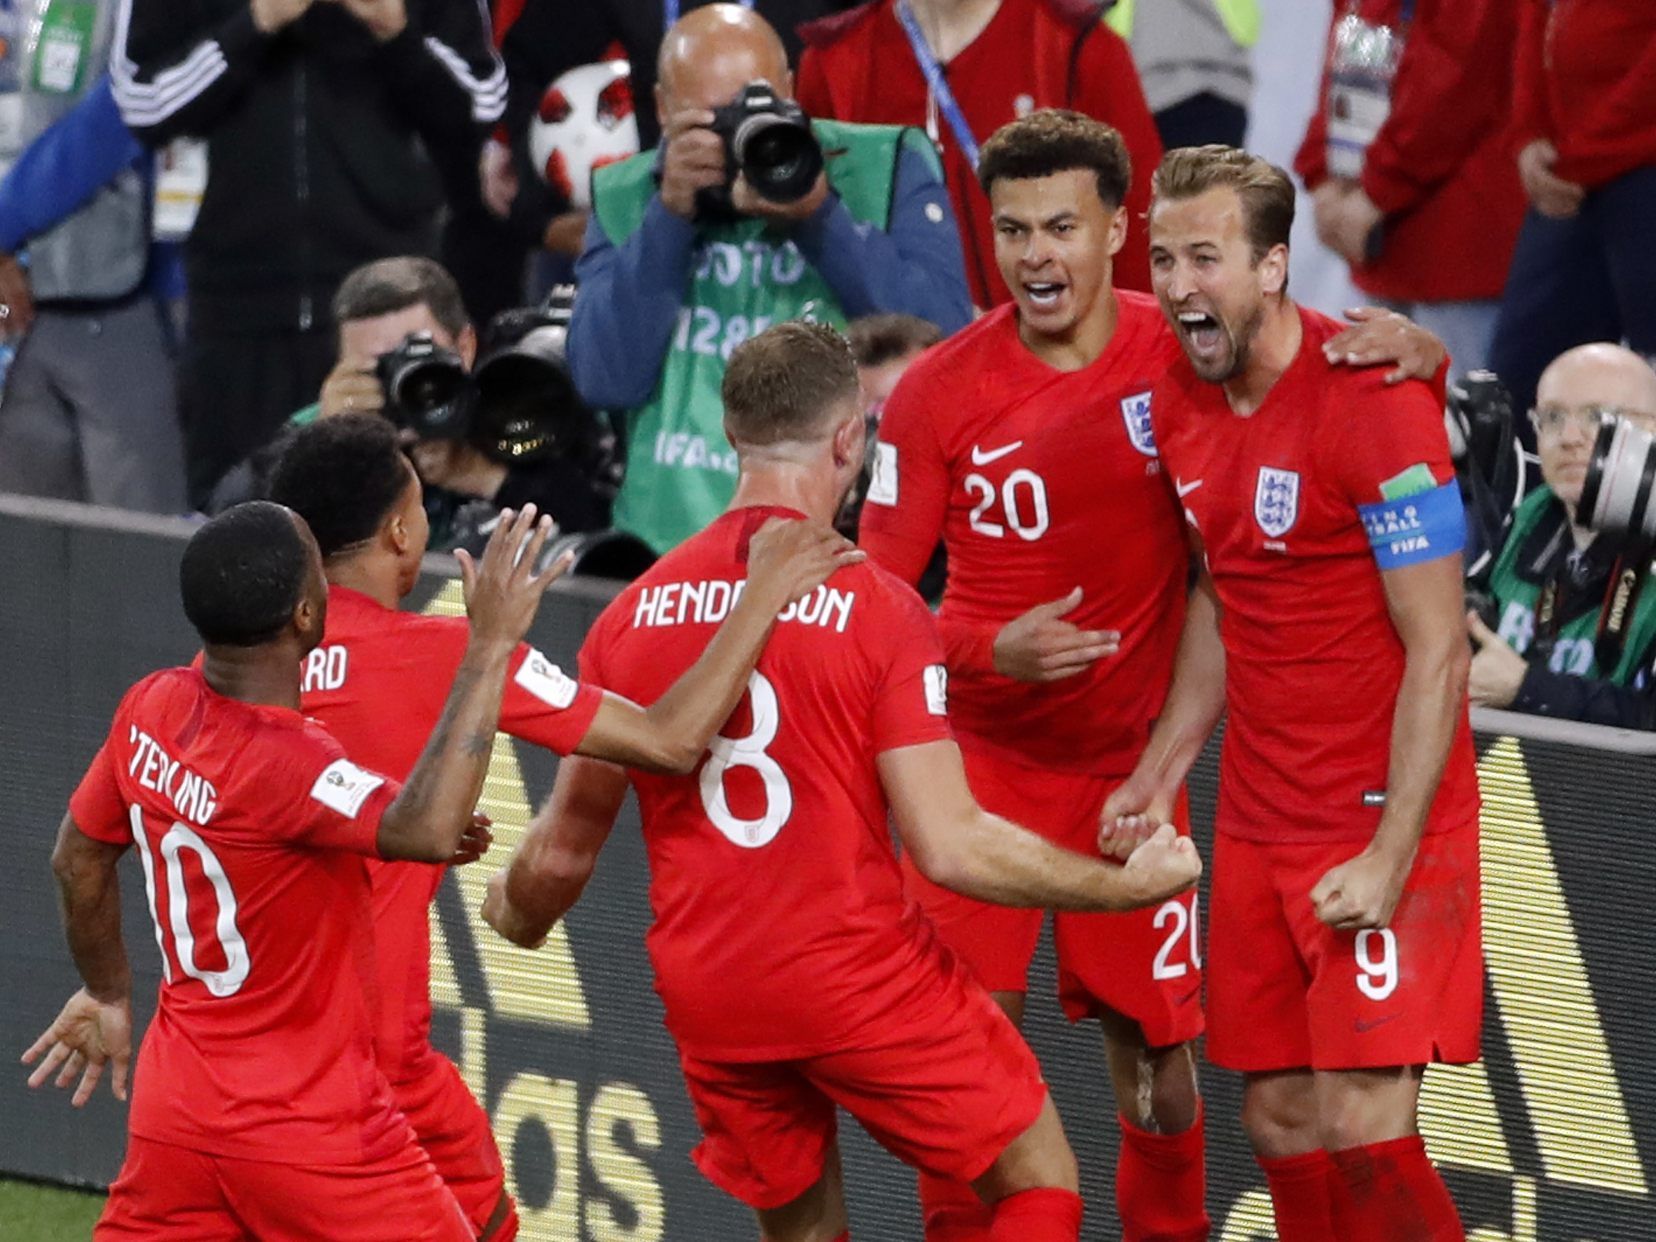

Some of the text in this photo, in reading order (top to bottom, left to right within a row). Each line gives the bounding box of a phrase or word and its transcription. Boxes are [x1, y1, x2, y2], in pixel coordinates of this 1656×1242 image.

[695, 239, 806, 288] OTO
[674, 305, 773, 362] 128
[964, 468, 1049, 541] 20
[1391, 535, 1431, 555] FIFA
[633, 579, 855, 633] HENDON
[300, 644, 347, 693] RD
[129, 723, 218, 826] TERLING
[699, 668, 793, 848] 8
[129, 802, 251, 998] 10
[1354, 927, 1400, 1001] 9
